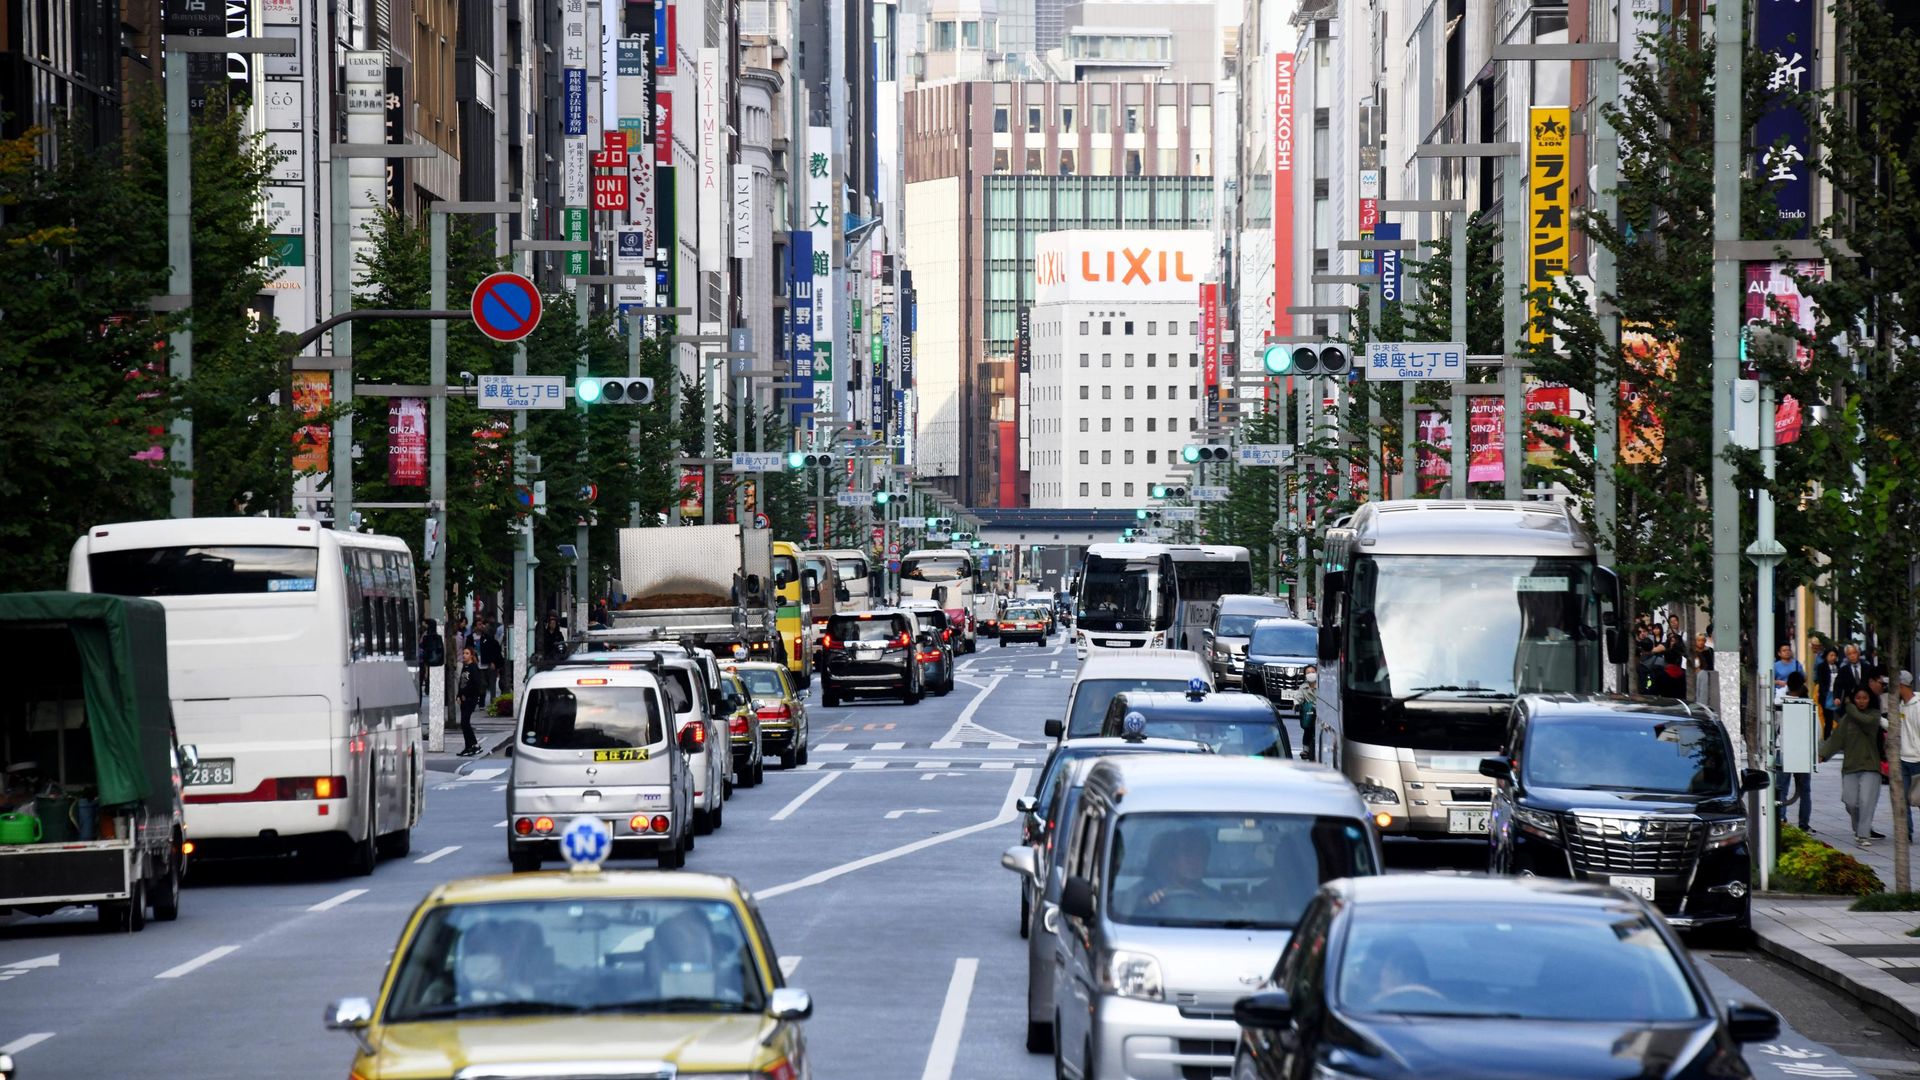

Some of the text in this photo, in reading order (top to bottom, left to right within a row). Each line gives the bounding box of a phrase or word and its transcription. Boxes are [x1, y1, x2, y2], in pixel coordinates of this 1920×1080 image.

[1277, 60, 1291, 171] MITSUKOSHI
[597, 179, 621, 191] UNI
[597, 194, 624, 206] QLO
[737, 176, 750, 249] TASAKI
[809, 152, 830, 277] 教文館
[571, 210, 582, 274] 西銀座療所
[1037, 250, 1066, 286] LIXIL
[1082, 247, 1193, 286] LIXIL
[796, 282, 811, 376] 山野楽器
[902, 335, 911, 372] ALBION
[1372, 344, 1399, 352] 中央区
[813, 348, 830, 375] 本
[1373, 352, 1459, 368] 銀座七丁目
[1398, 368, 1433, 377] Ginza 7
[484, 384, 560, 398] 銀座七丁目
[507, 398, 537, 406] Ginza 7
[1527, 402, 1557, 411] GINZA
[735, 456, 779, 466] 銀座六丁目
[1242, 449, 1290, 459] 銀座六丁目
[595, 750, 648, 760] 高圧ガス
[191, 767, 232, 784] 28-89
